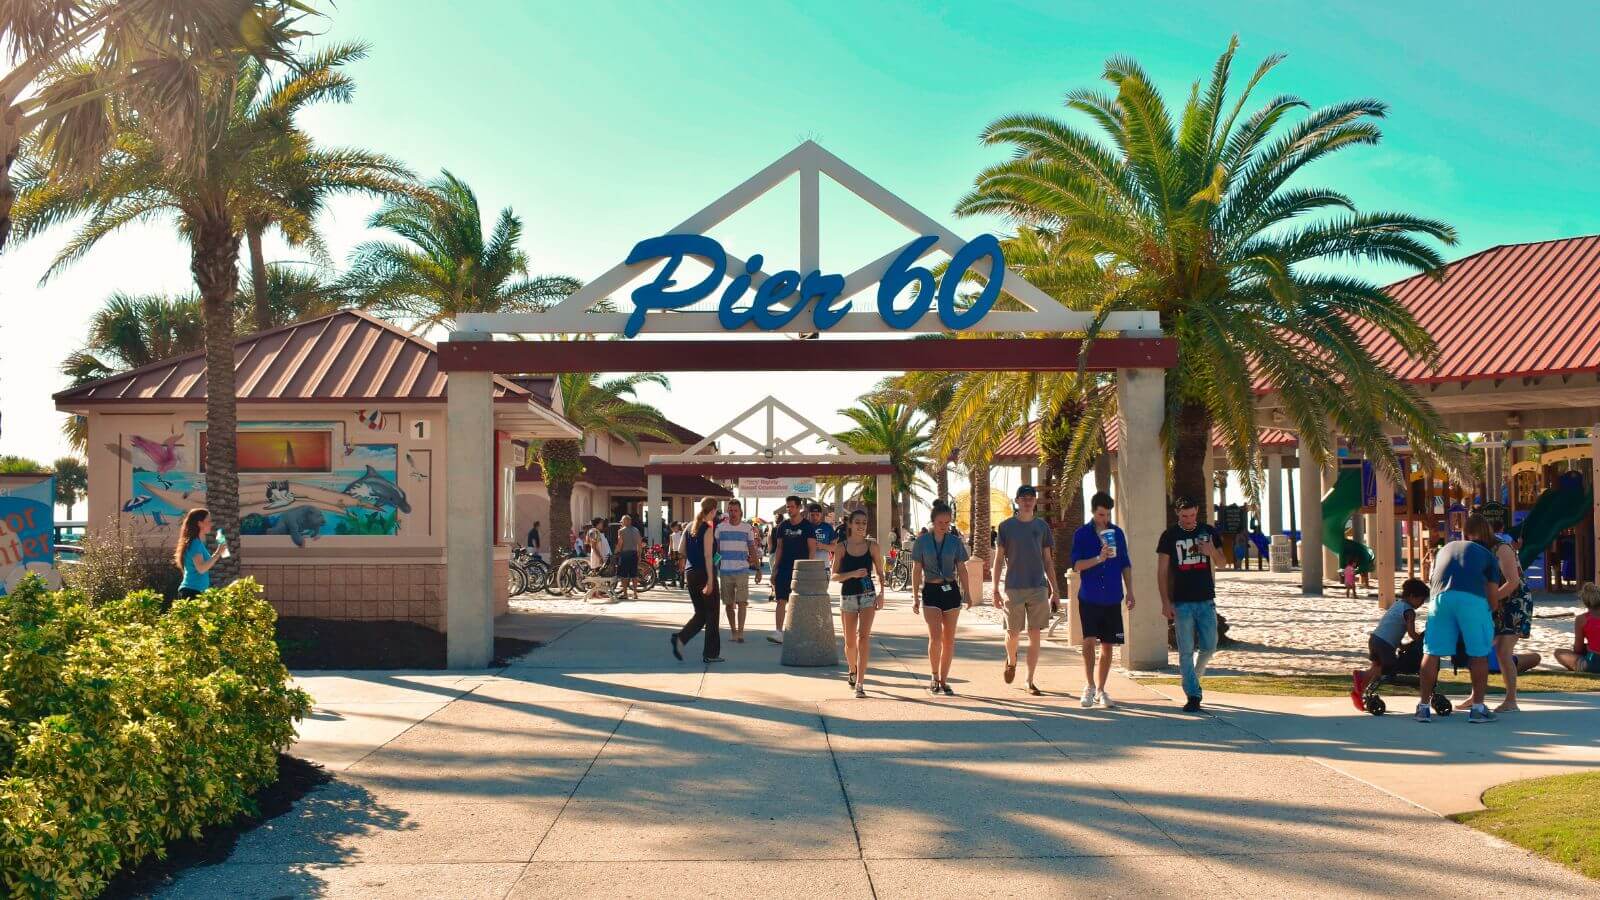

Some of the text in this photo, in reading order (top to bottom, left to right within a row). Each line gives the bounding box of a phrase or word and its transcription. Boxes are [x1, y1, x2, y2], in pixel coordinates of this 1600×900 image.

[624, 233, 1005, 339] Pier 60
[414, 421, 424, 438] 1
